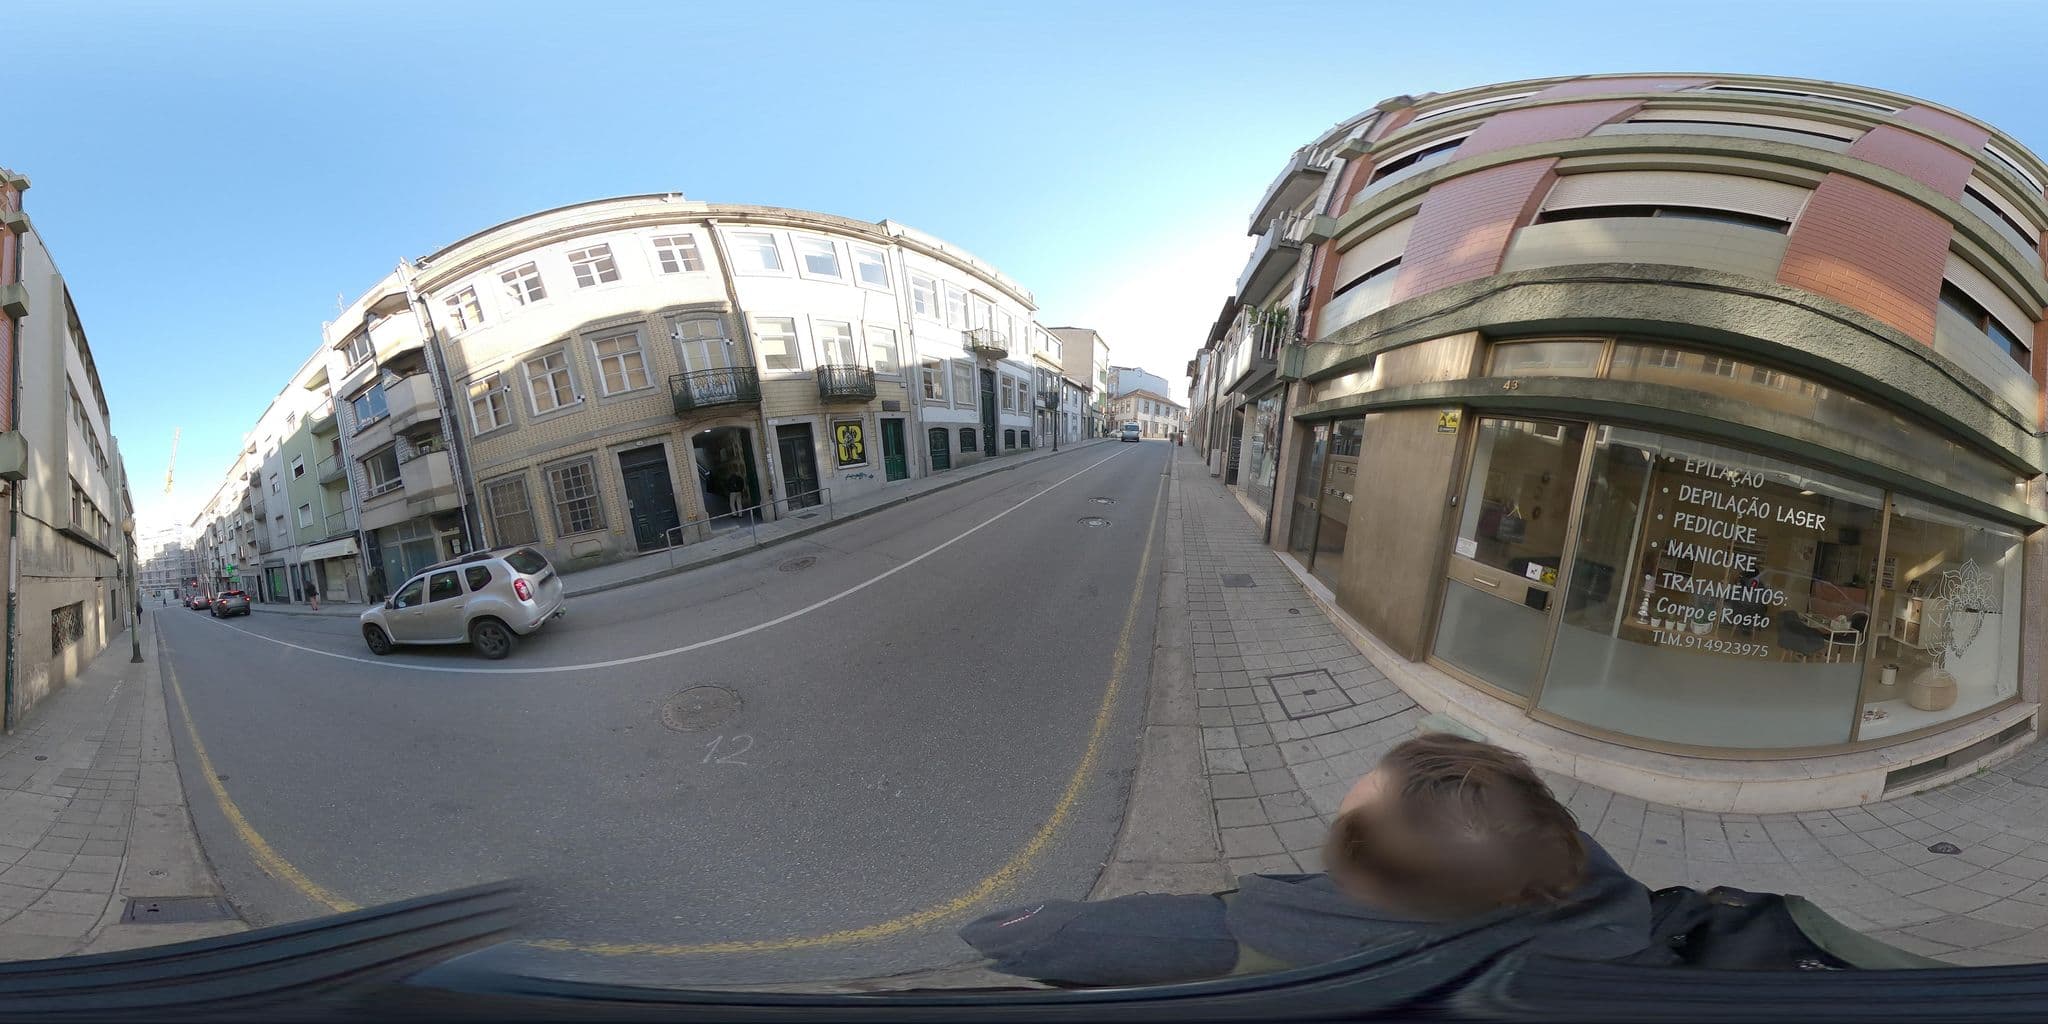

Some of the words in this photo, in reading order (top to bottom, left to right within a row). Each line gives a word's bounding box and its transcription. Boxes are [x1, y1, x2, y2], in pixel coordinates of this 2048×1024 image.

[1503, 380, 1518, 390] 43
[1678, 484, 1770, 519] DEPILAÇÃO
[1776, 505, 1826, 531] LASER
[1673, 511, 1758, 544] PEDICURE
[1667, 539, 1757, 572] MANICURE
[1662, 572, 1788, 607] TRATAMENTOS:
[1656, 597, 1704, 623] Corpo
[1708, 610, 1717, 622] e
[1720, 607, 1770, 628] Rosto
[703, 735, 754, 765] 12
